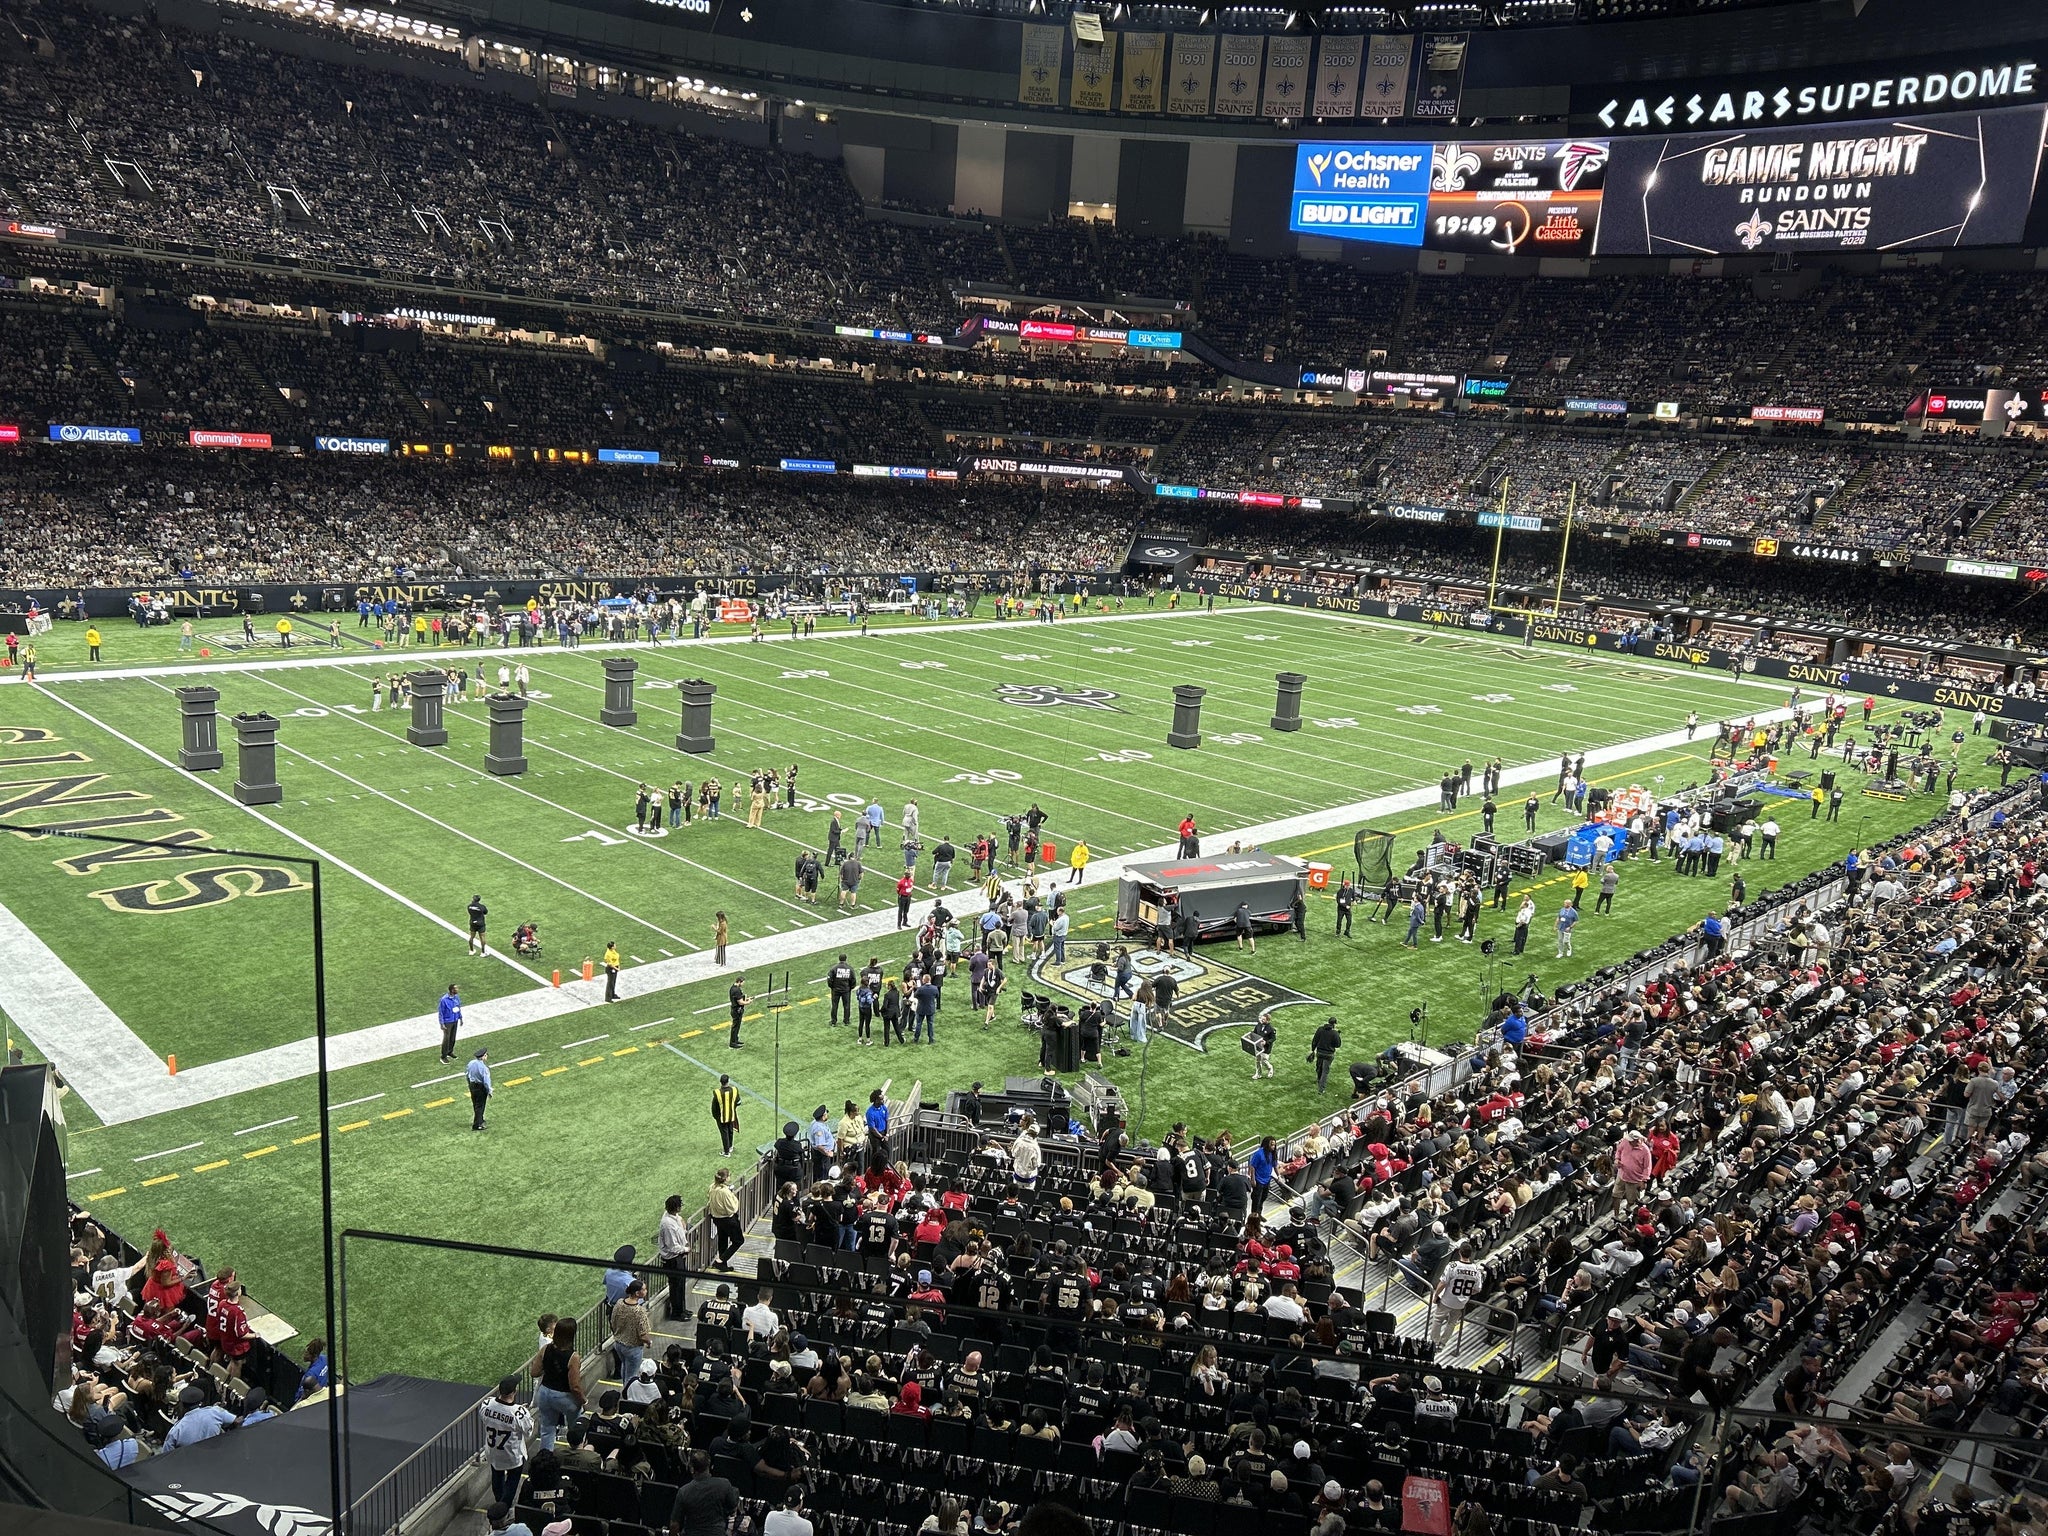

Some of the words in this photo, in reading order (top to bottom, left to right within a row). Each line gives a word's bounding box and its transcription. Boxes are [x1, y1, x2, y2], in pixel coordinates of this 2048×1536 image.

[1179, 53, 1205, 65] 1991
[1225, 54, 1256, 65] 2000
[1272, 56, 1304, 67] 2006
[1324, 55, 1355, 66] 2009
[1373, 54, 1405, 66] 2009
[1598, 87, 1790, 128] CAESARS
[1797, 63, 2037, 114] SUPERDOME
[1075, 100, 1105, 108] HOLDERS
[1170, 102, 1206, 113] SAINTS
[1217, 103, 1253, 114] SAINTS
[1265, 105, 1301, 115] SAINTS
[1316, 105, 1352, 115] SAINTS
[1364, 105, 1401, 115] SAINTS
[1416, 104, 1455, 115] SAINTS
[1334, 151, 1422, 171] Ochsner
[1493, 147, 1546, 161] SAINTS
[1702, 142, 1800, 185] GAME
[1808, 134, 1928, 180] NIGHT
[1334, 174, 1390, 189] Health
[1493, 177, 1538, 187] FALCONS
[1740, 182, 1872, 204] RUNDOWN
[1302, 205, 1348, 224] BUD
[1350, 206, 1411, 225] LIGHT
[1546, 215, 1578, 229] Little
[1776, 207, 1871, 231] SAINTS
[1436, 216, 1496, 235] 19:49
[1535, 226, 1583, 240] Caesars
[1776, 231, 1799, 239] SMALL
[1800, 230, 1832, 239] BUSINESS
[1833, 229, 1868, 238] PARTNER
[394, 307, 442, 321] CAESARS
[443, 312, 496, 326] SUPERDOME
[988, 321, 1018, 331] REPDATA
[1089, 329, 1127, 339] CABINETRY
[1138, 333, 1156, 343] BBC
[1316, 373, 1343, 386] Meta
[1481, 379, 1509, 389] Keesler
[1566, 401, 1598, 410] VENTURE
[1598, 402, 1627, 411] GLOBAL
[1689, 404, 1720, 414] SAINTS
[1946, 400, 1985, 410] TOYOTA
[1752, 407, 1783, 419] ROUSES
[1784, 409, 1823, 420] MARKETS
[1834, 409, 1868, 420] SAINTS
[145, 431, 184, 442] SAINTS
[193, 432, 243, 446] Community
[328, 439, 387, 454] Ochsner
[712, 458, 739, 468] entergy
[980, 459, 1017, 472] SAINTS
[1019, 463, 1047, 473] SMALL
[1048, 465, 1086, 476] BUSINESS
[1207, 491, 1239, 499] REPDATA
[1395, 506, 1444, 521] Ochsner
[1512, 516, 1540, 529] HEALTH
[1629, 526, 1660, 537] SAINTS
[1702, 537, 1732, 547] TOYOTA
[1756, 539, 1776, 554] 25
[1793, 545, 1859, 562] CAESARS
[1873, 549, 1911, 564] SAINTS
[1299, 559, 1402, 577] CAESARS
[1404, 572, 1534, 592] SUPERDOME
[357, 585, 441, 604] SAINTS
[1317, 596, 1360, 611] SAINTS
[1534, 624, 1585, 644] SAINTS
[1655, 604, 1791, 629] CAESARS
[1791, 623, 1963, 650] SUPERDOME
[1934, 689, 2004, 713] SAINTS
[1216, 860, 1272, 871] NFL
[1313, 872, 1323, 883] G
[1168, 1000, 1232, 1028] 1967
[1186, 1160, 1198, 1178] 8
[868, 1225, 886, 1242] 13
[96, 1281, 115, 1299] 41
[889, 1282, 900, 1297] 7
[1452, 1278, 1476, 1296] 88
[979, 1286, 1000, 1310] 12
[1058, 1287, 1080, 1308] 56
[707, 1301, 731, 1311] GLEASON
[220, 1318, 227, 1332] 2
[484, 1408, 514, 1425] GLEASON
[515, 1405, 527, 1419] 37
[486, 1427, 512, 1450] 37
[1378, 1452, 1400, 1463] KAMARA
